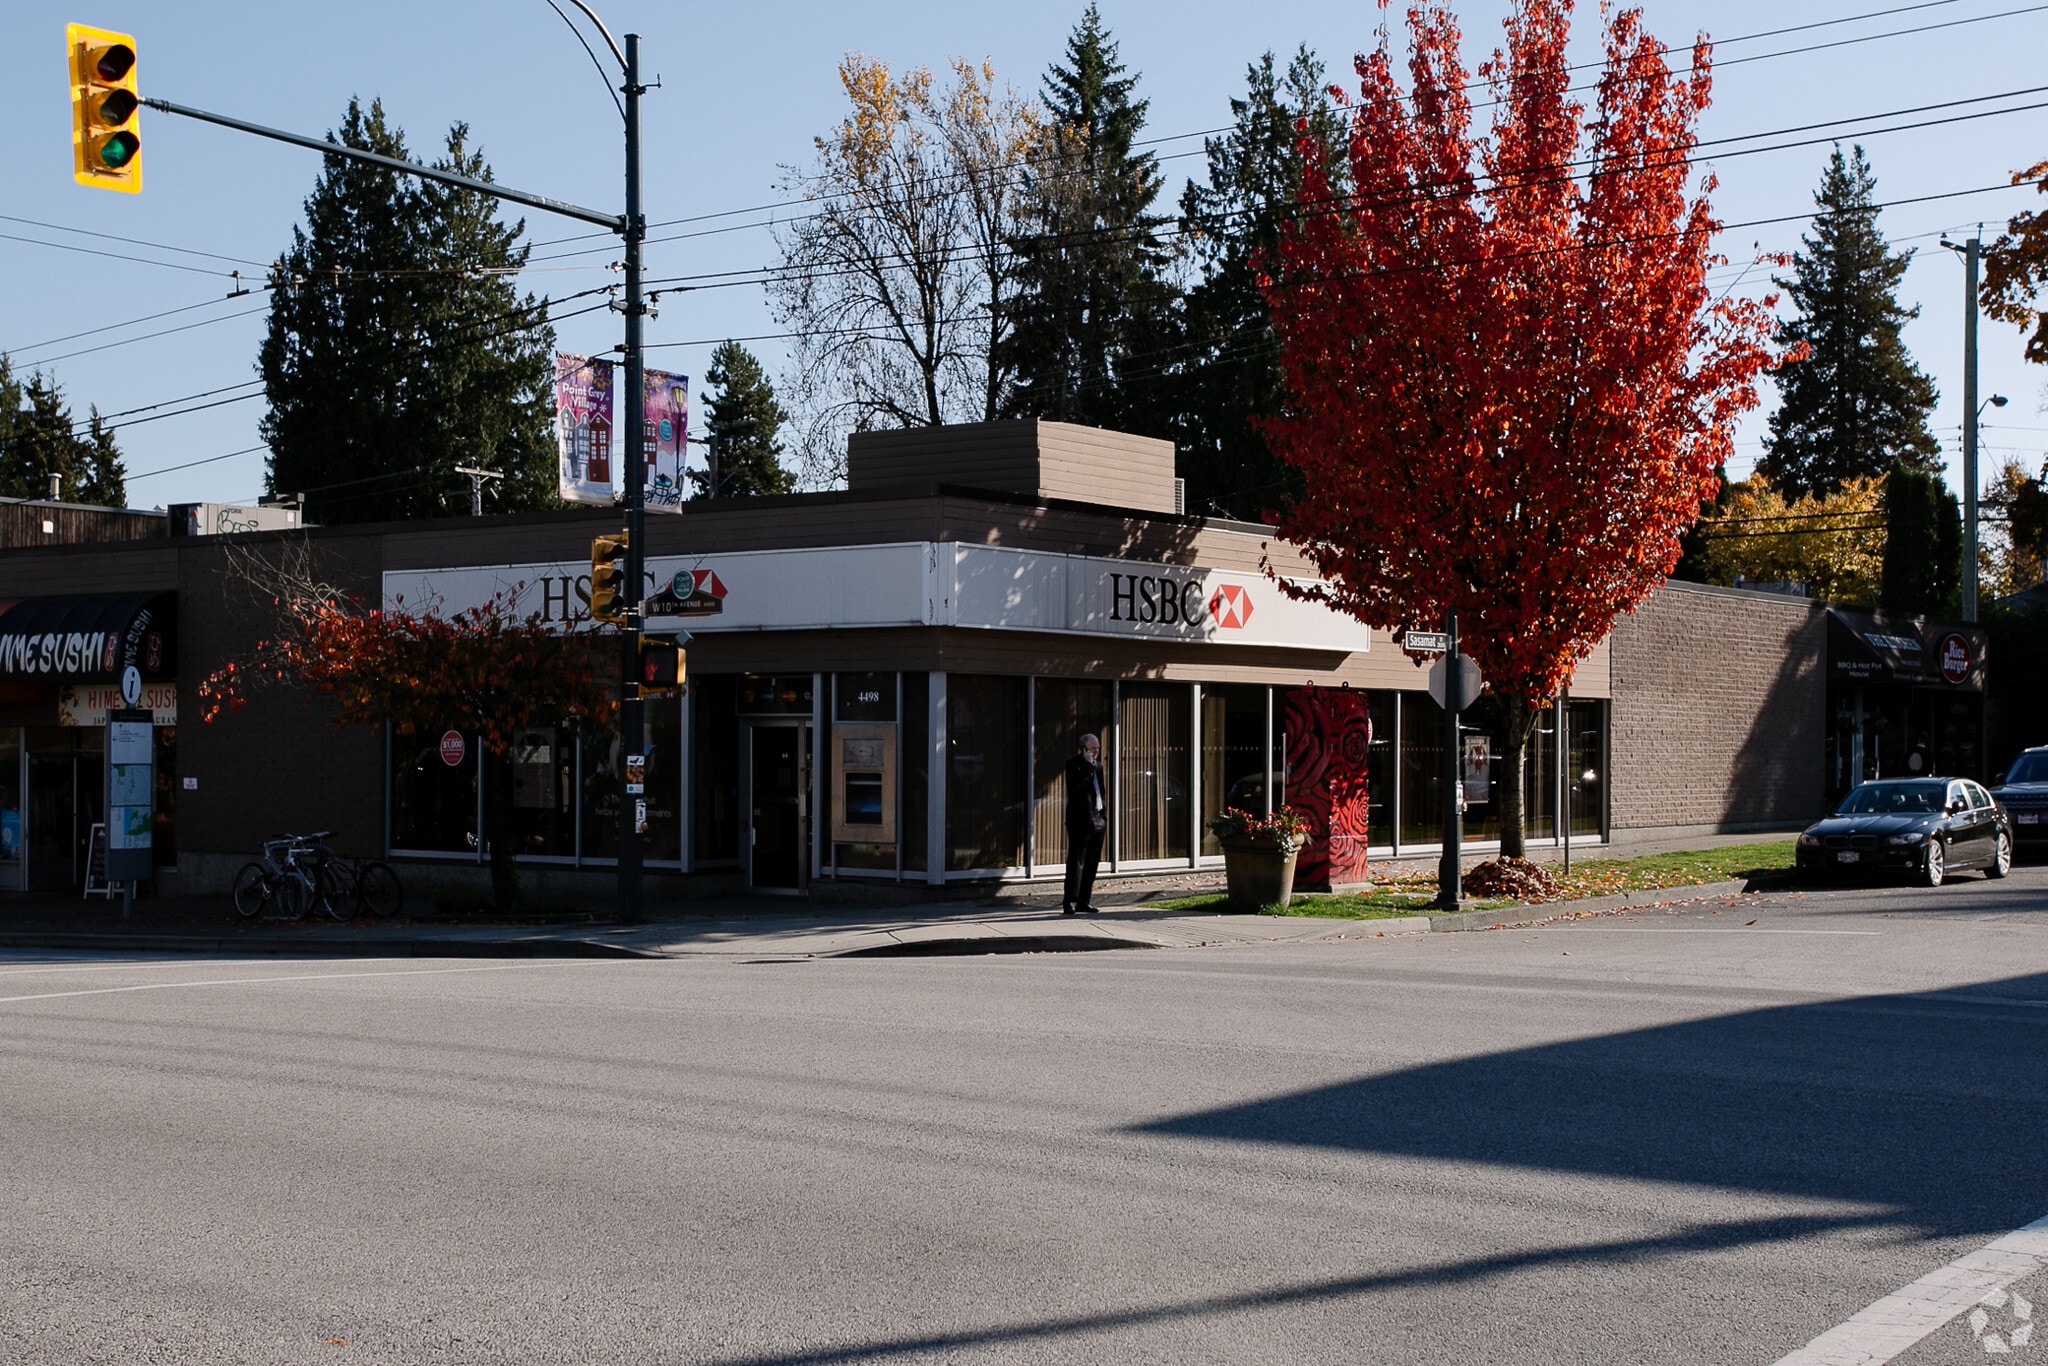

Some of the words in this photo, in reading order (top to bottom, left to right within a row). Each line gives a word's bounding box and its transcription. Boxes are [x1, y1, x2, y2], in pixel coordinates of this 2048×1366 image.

[562, 382, 587, 396] Point
[588, 386, 606, 401] Grey
[571, 395, 597, 412] Village
[652, 603, 660, 612] W
[1110, 573, 1204, 627] HSBC
[127, 609, 153, 644] SUSHI
[1410, 635, 1436, 647] Sasamat
[1949, 640, 1965, 659] Rice
[40, 632, 105, 673] SUSHI
[1837, 661, 1851, 669] BBQ
[1852, 661, 1858, 669] &
[1858, 662, 1870, 670] Hot
[1871, 662, 1882, 670] Pot
[1943, 651, 1969, 674] Burger
[88, 690, 121, 709] HIME
[857, 690, 880, 702] 4498
[443, 740, 463, 749] $1,000
